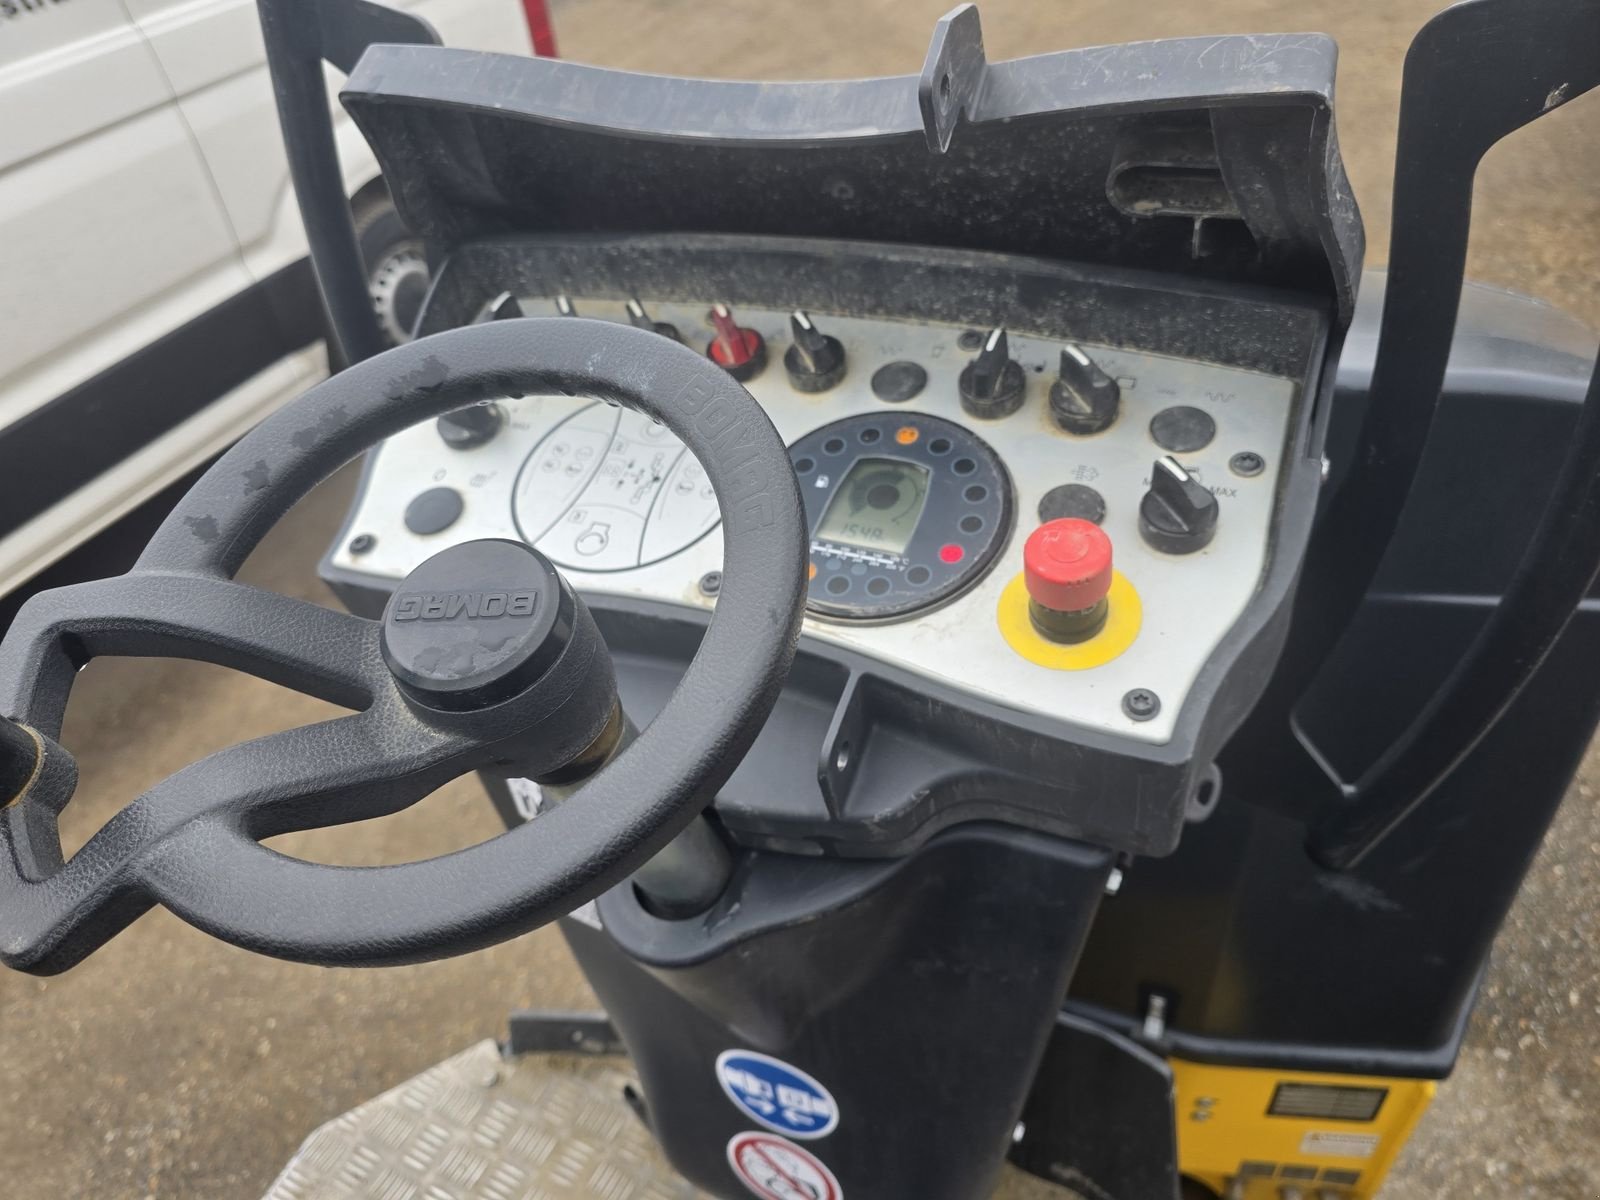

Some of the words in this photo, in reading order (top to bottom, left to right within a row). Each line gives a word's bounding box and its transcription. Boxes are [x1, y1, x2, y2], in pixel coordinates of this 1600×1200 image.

[673, 374, 773, 536] BOMAG
[1211, 486, 1237, 497] MAX
[395, 590, 538, 622] BOMAG
